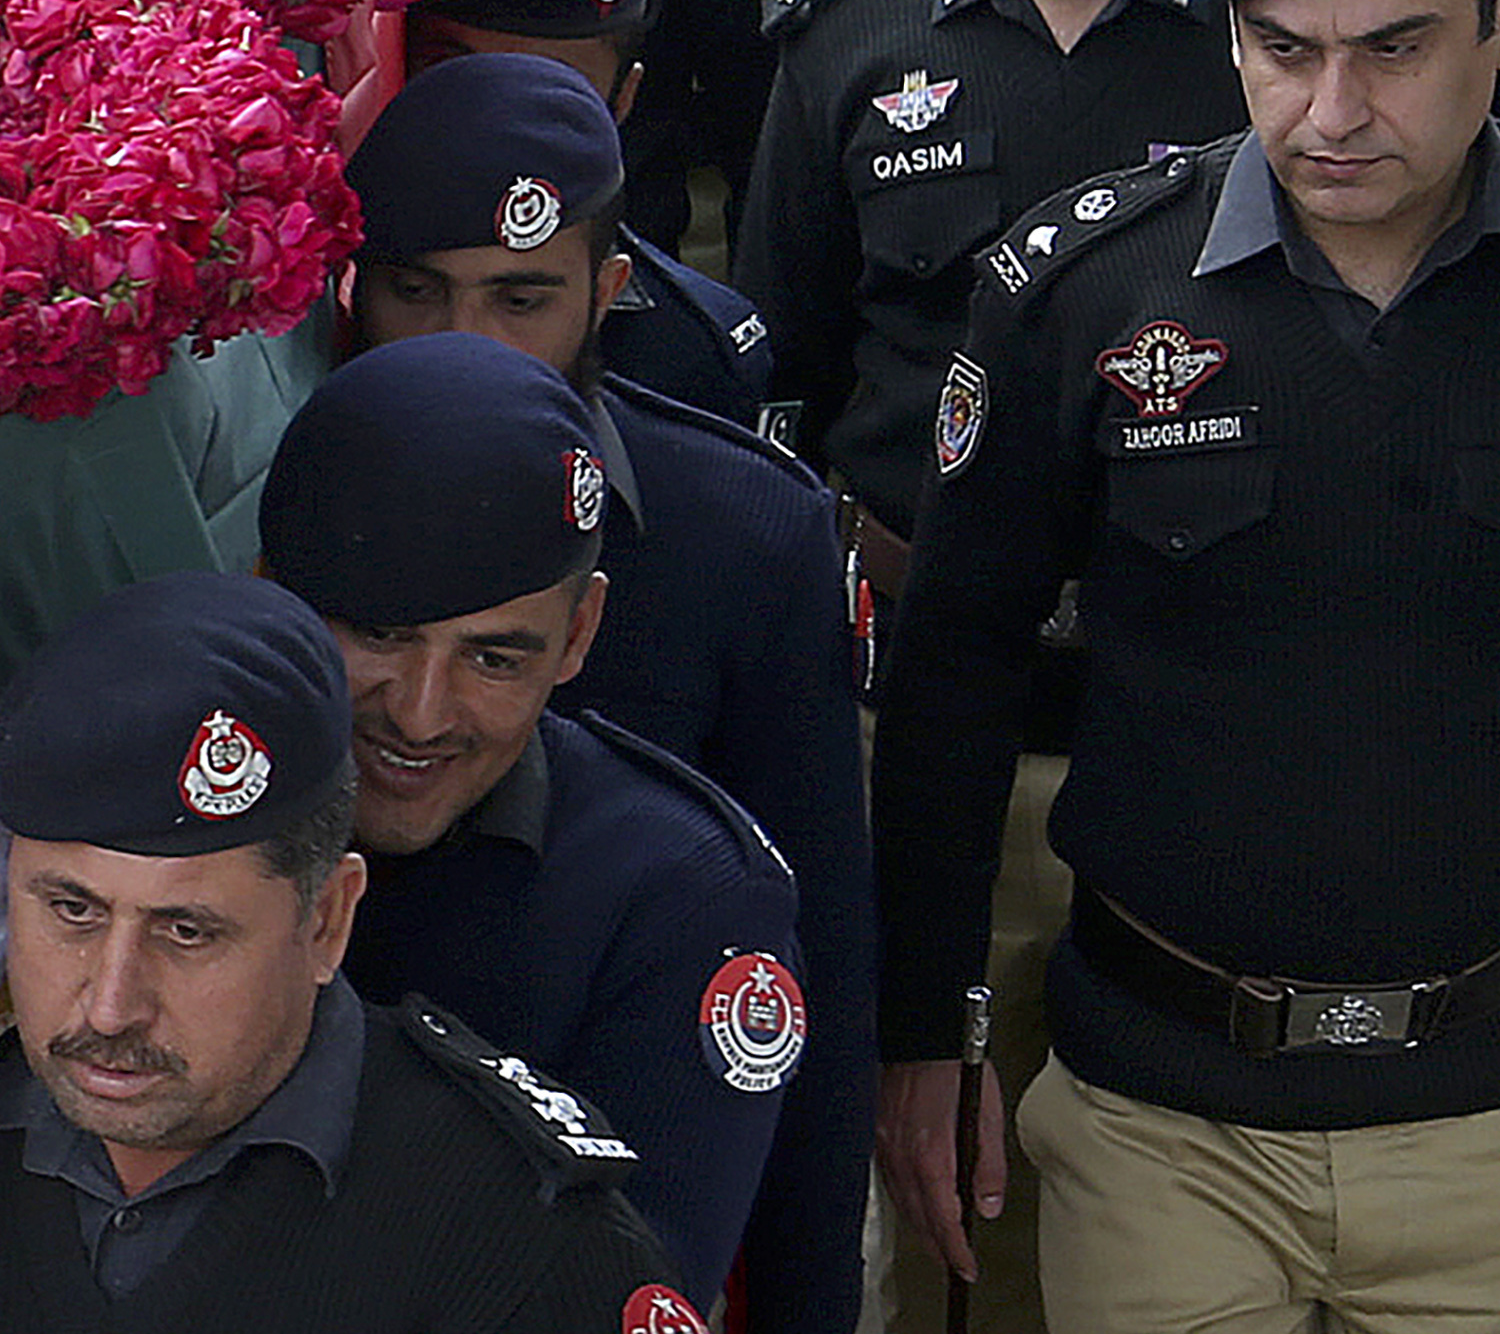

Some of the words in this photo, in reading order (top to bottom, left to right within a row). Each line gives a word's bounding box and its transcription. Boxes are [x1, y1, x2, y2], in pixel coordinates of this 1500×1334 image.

[873, 141, 963, 180] QASIM
[1143, 396, 1179, 413] ATS
[1122, 423, 1185, 450] ZAHOOR
[1187, 415, 1242, 445] AFRIDI
